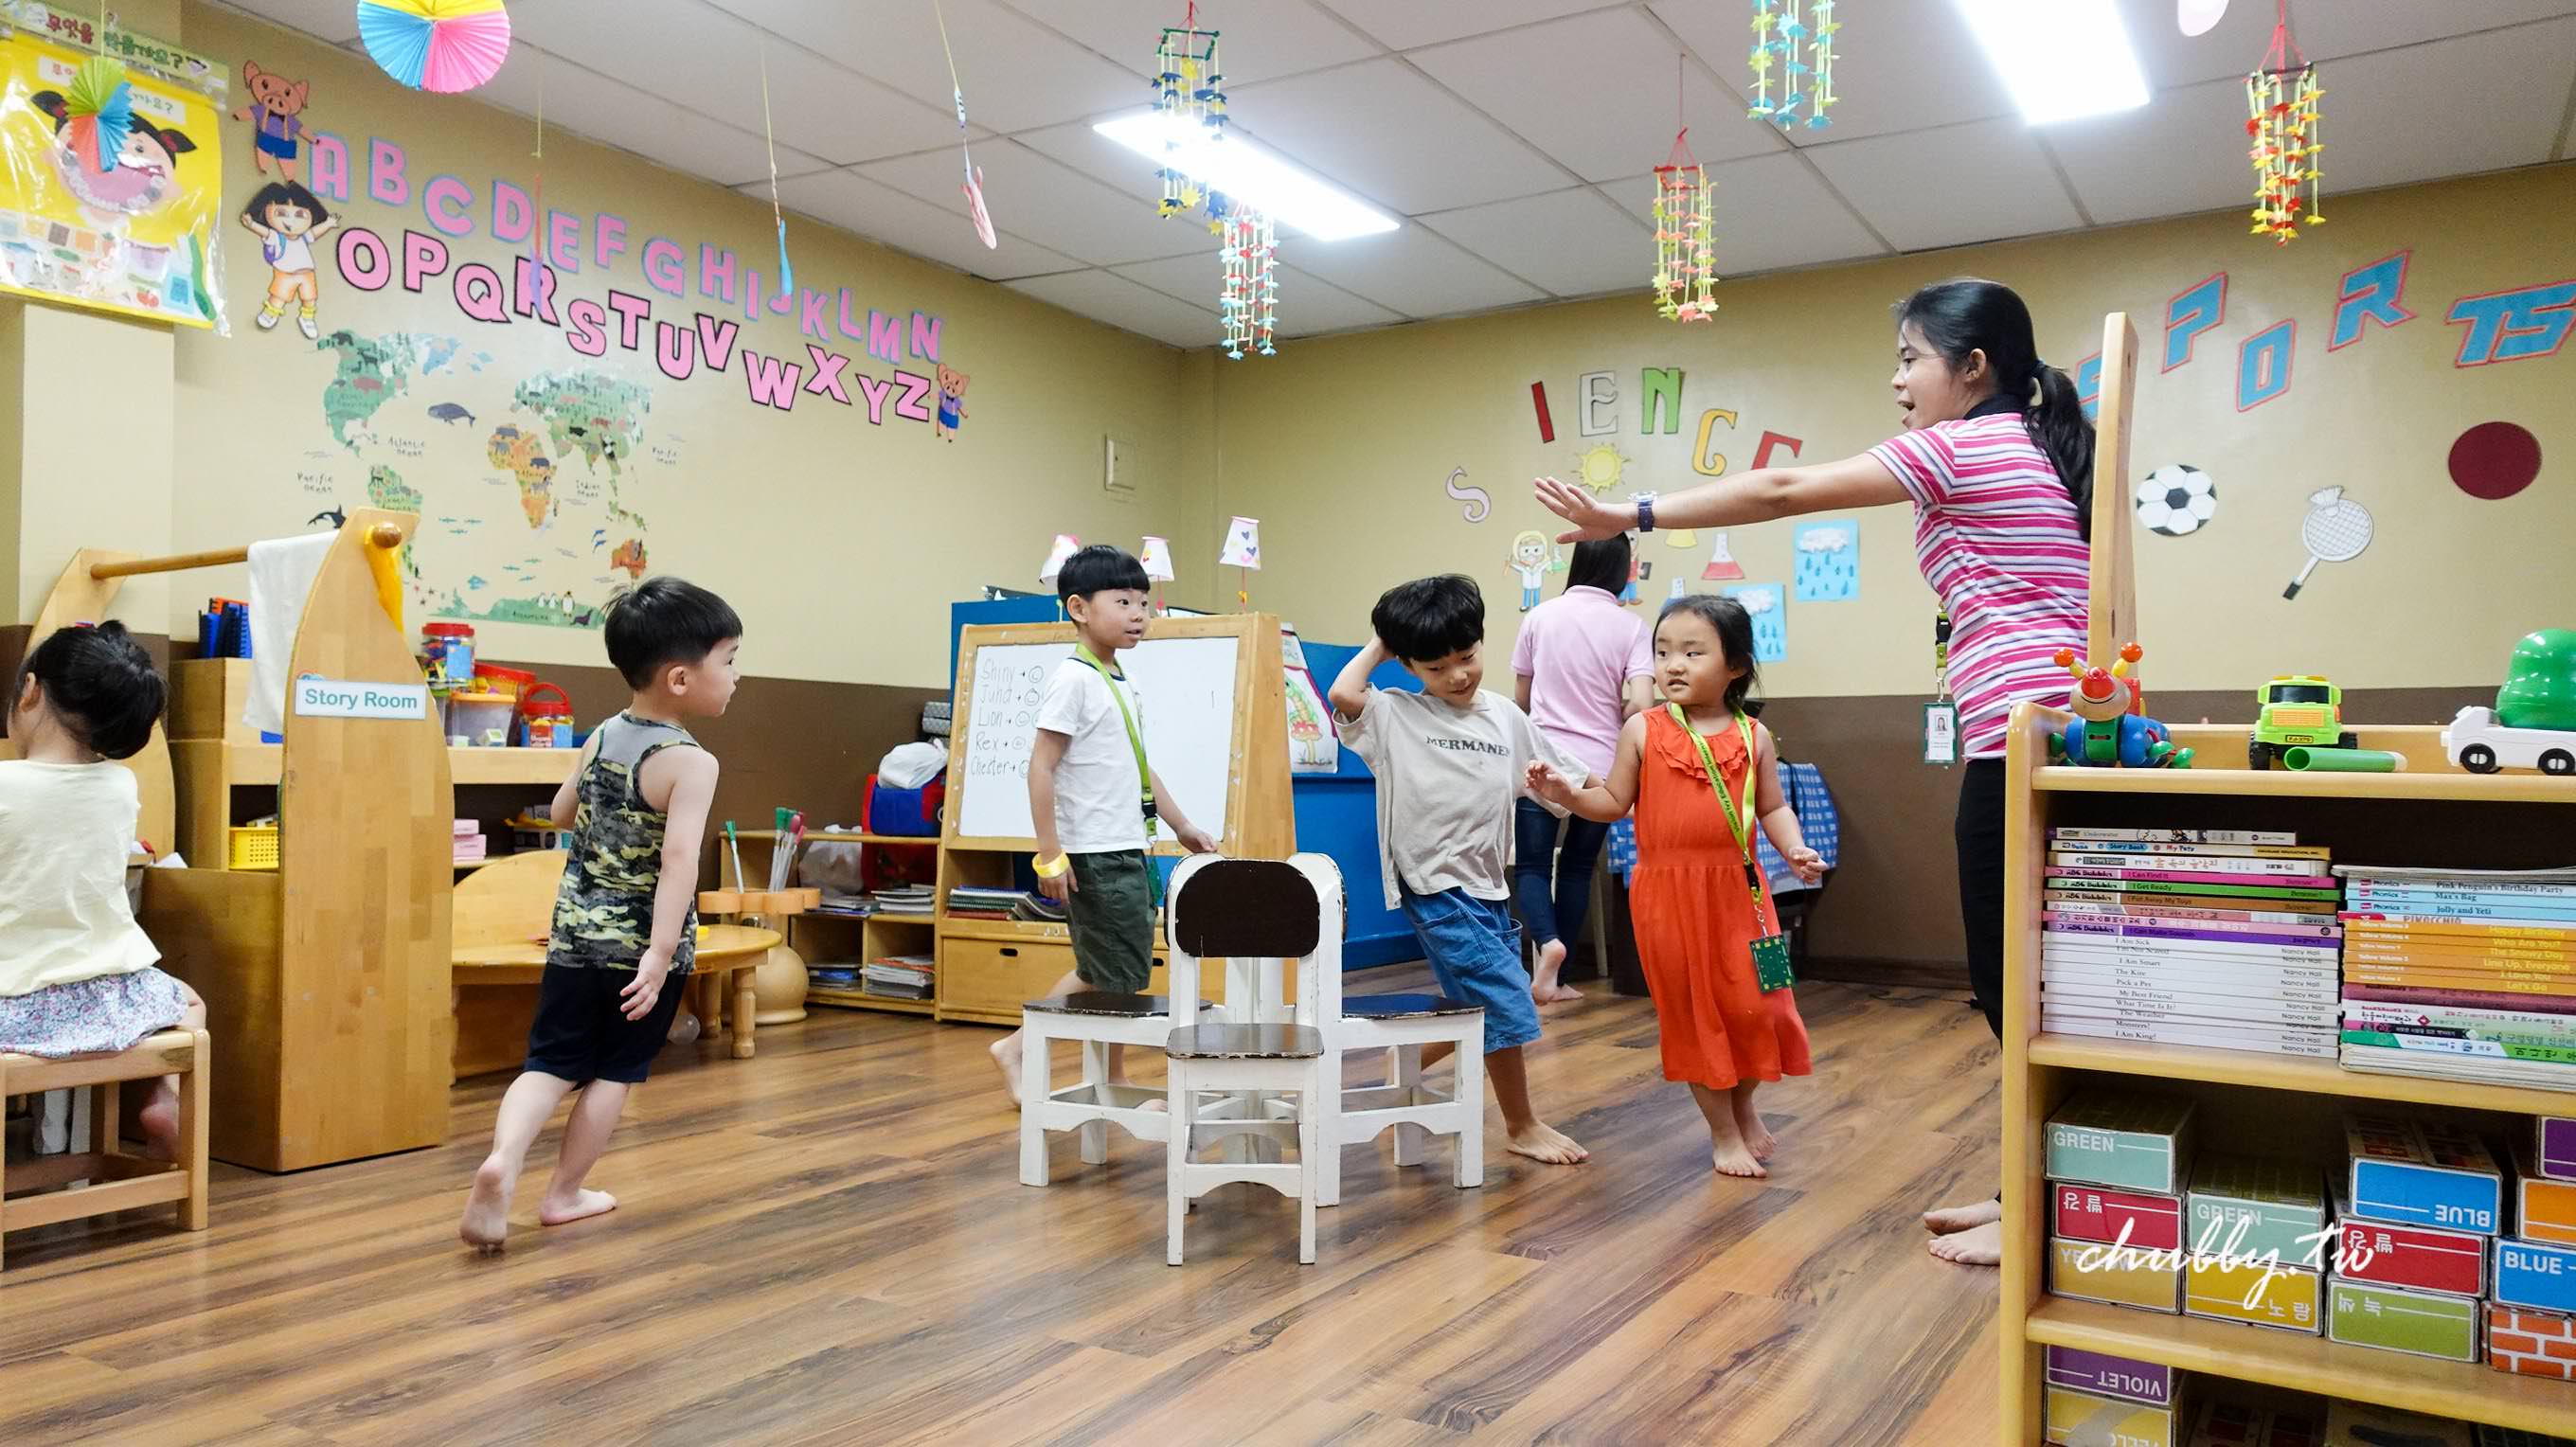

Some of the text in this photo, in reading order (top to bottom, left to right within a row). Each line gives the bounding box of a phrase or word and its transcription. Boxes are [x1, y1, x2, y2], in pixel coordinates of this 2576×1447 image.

[304, 688, 418, 710] Story Room
[975, 731, 999, 751] Rex
[2500, 884, 2537, 894] Birthday
[2540, 885, 2564, 894] Party
[2526, 960, 2570, 972] Everyone
[2281, 1045, 2304, 1053] Nancy
[2053, 1132, 2115, 1152] GREEN
[2197, 1204, 2262, 1225] GREEN
[2435, 1205, 2491, 1227] BLUE
[2505, 1251, 2563, 1275] BLUE
[2097, 1370, 2162, 1397] VIOLET
